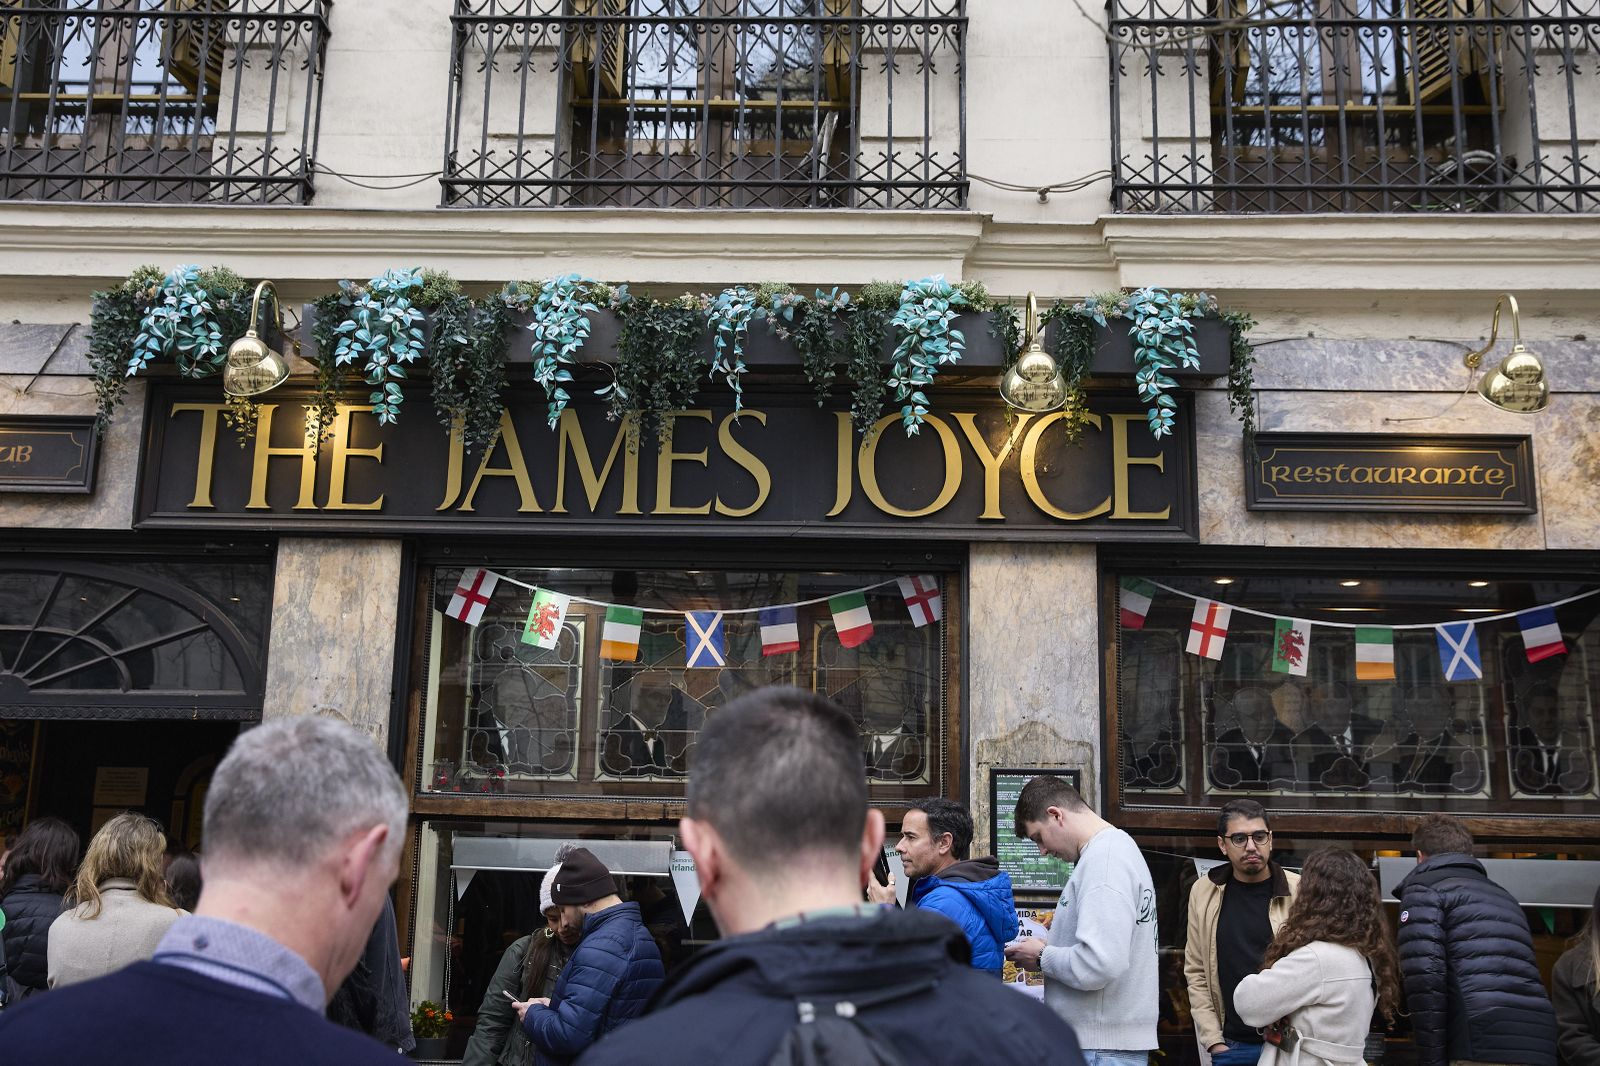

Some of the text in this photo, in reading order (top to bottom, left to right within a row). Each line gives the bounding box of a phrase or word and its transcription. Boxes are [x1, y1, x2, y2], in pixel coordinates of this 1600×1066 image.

[0, 445, 33, 463] UB
[171, 402, 1171, 521] THE JAMES JOYCE
[672, 864, 696, 872] Irland
[1015, 910, 1038, 918] MIDA
